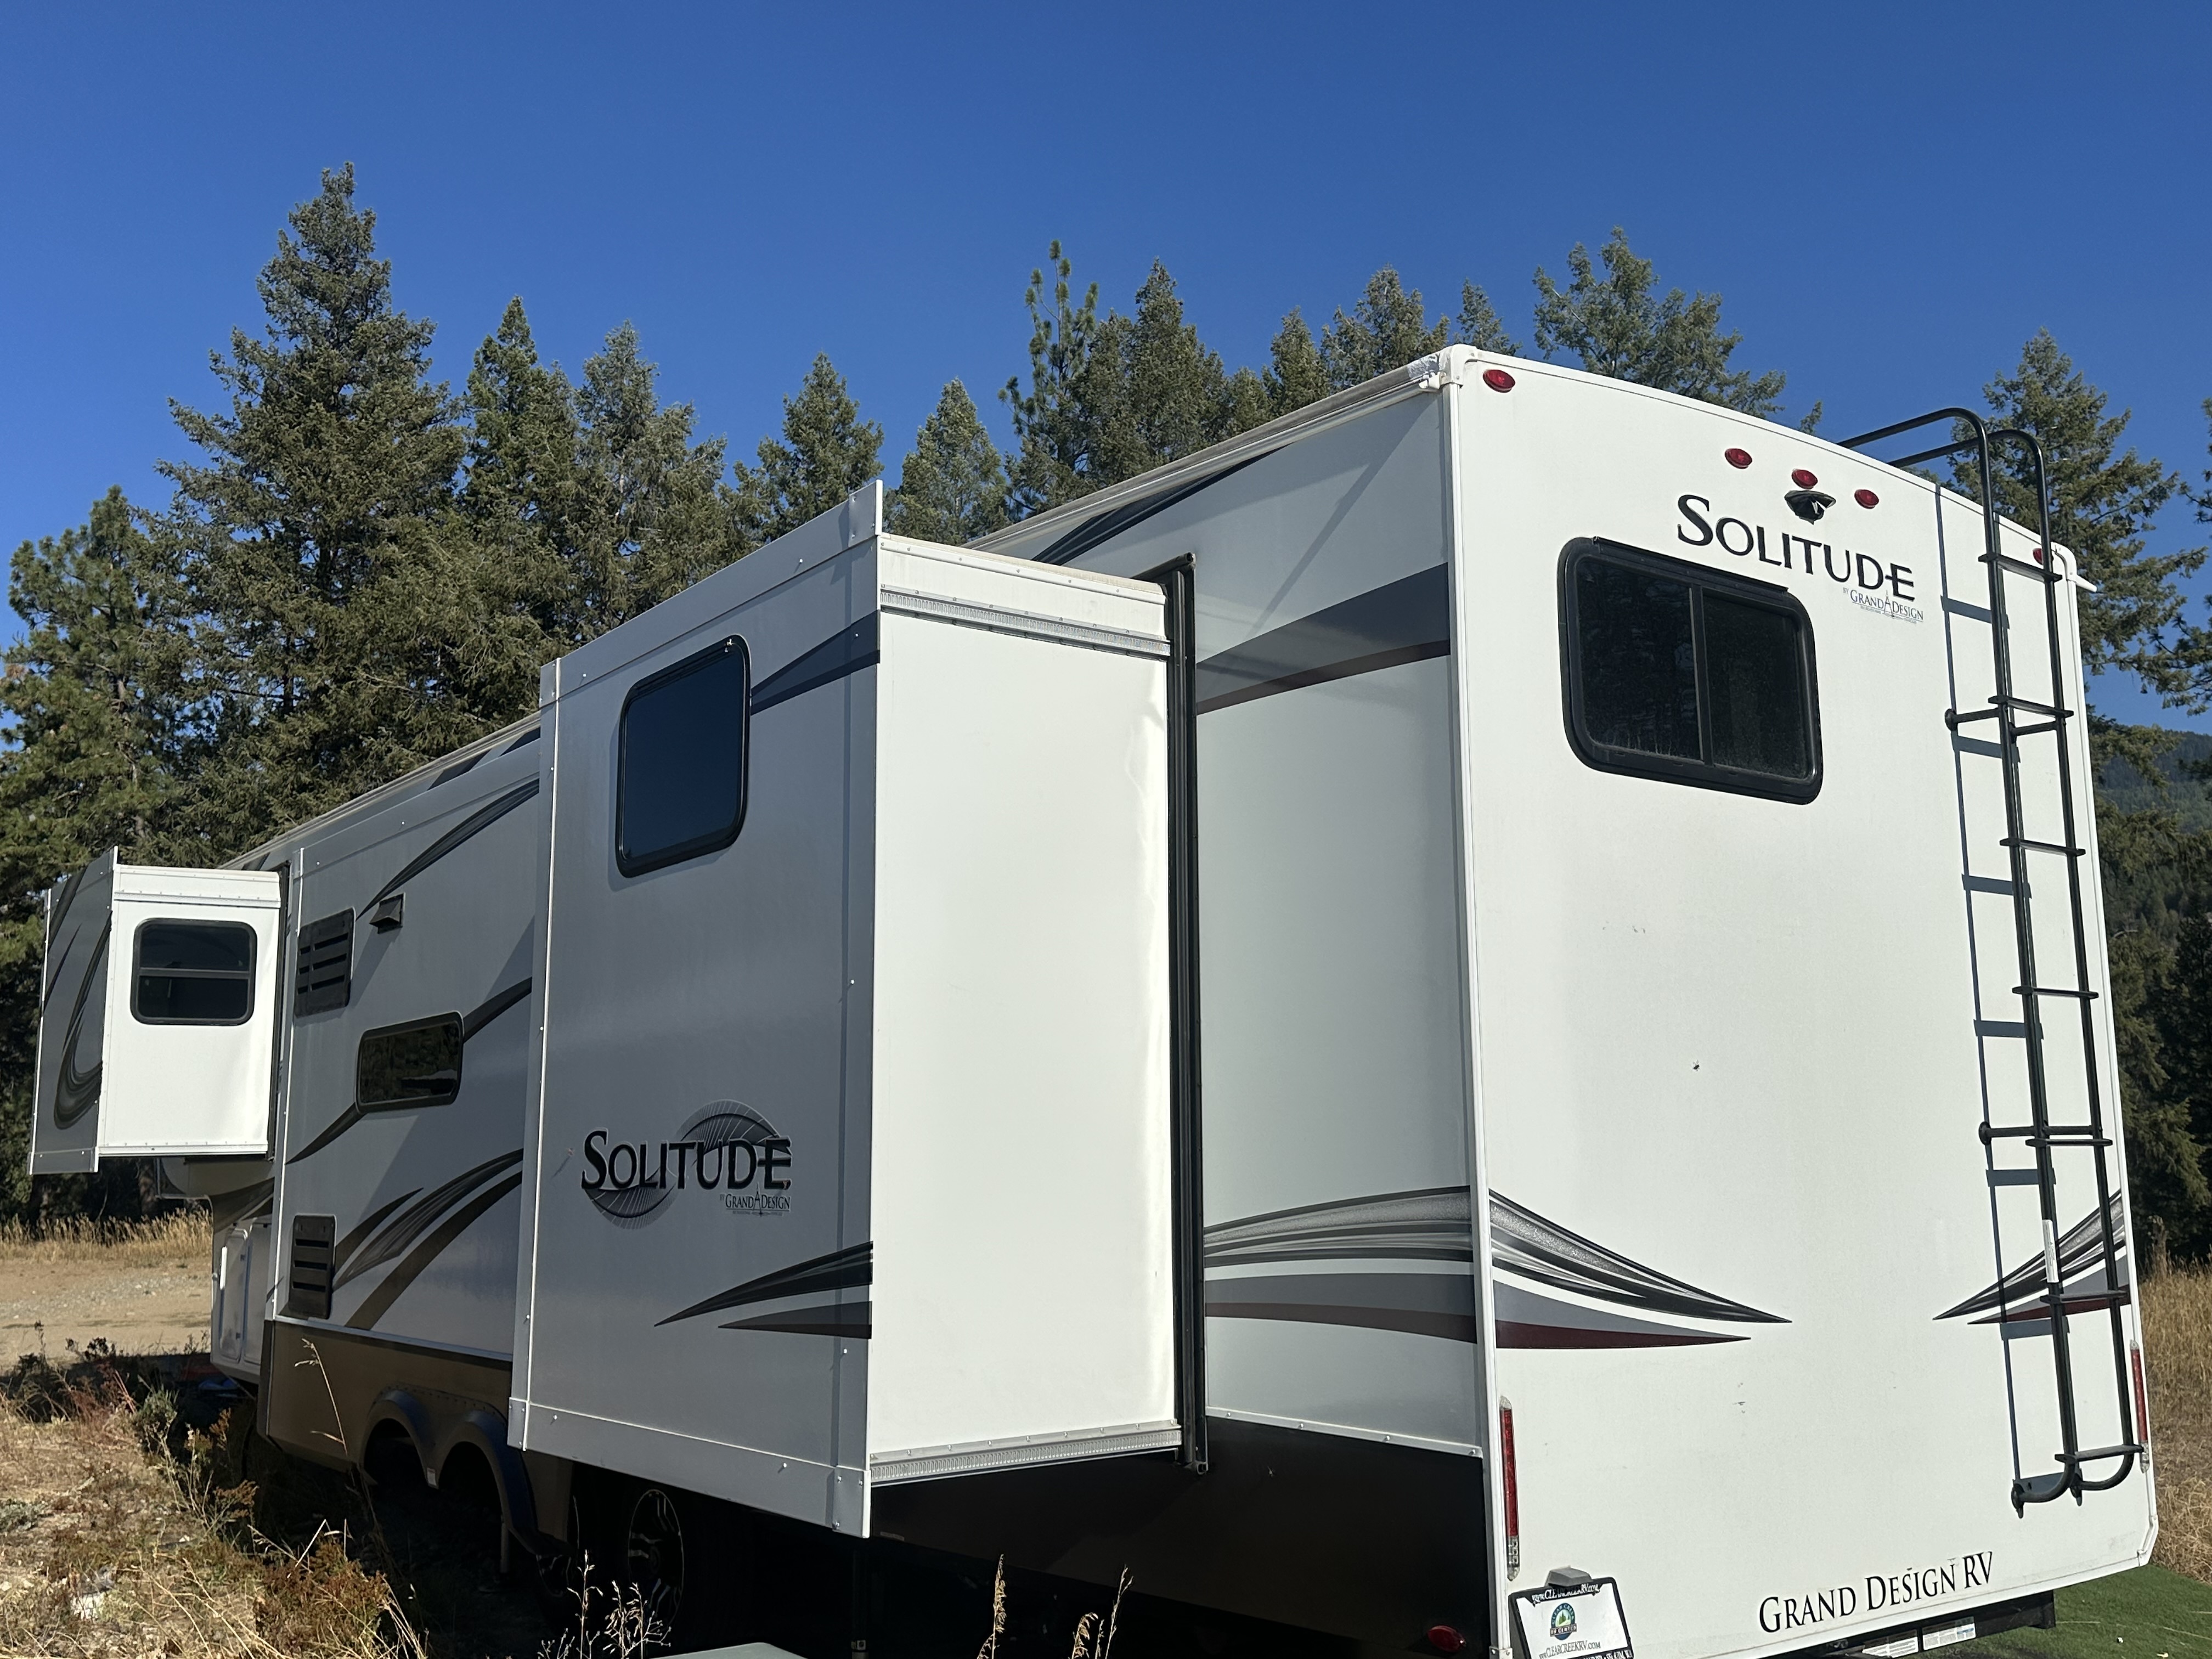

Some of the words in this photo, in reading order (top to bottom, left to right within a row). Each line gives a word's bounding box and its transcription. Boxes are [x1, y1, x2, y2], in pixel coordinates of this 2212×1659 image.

[1677, 494, 1916, 602] SOLITUDE
[1850, 589, 1884, 609] GRAND
[1892, 600, 1923, 620] DESIGN
[580, 1129, 792, 1190] SOLITUDE
[725, 1194, 754, 1208] GRAND
[761, 1194, 790, 1209] DESIGN
[1759, 1586, 1857, 1633] GRAND
[1864, 1564, 1956, 1611] DESIGN
[1961, 1551, 1993, 1589] RV
